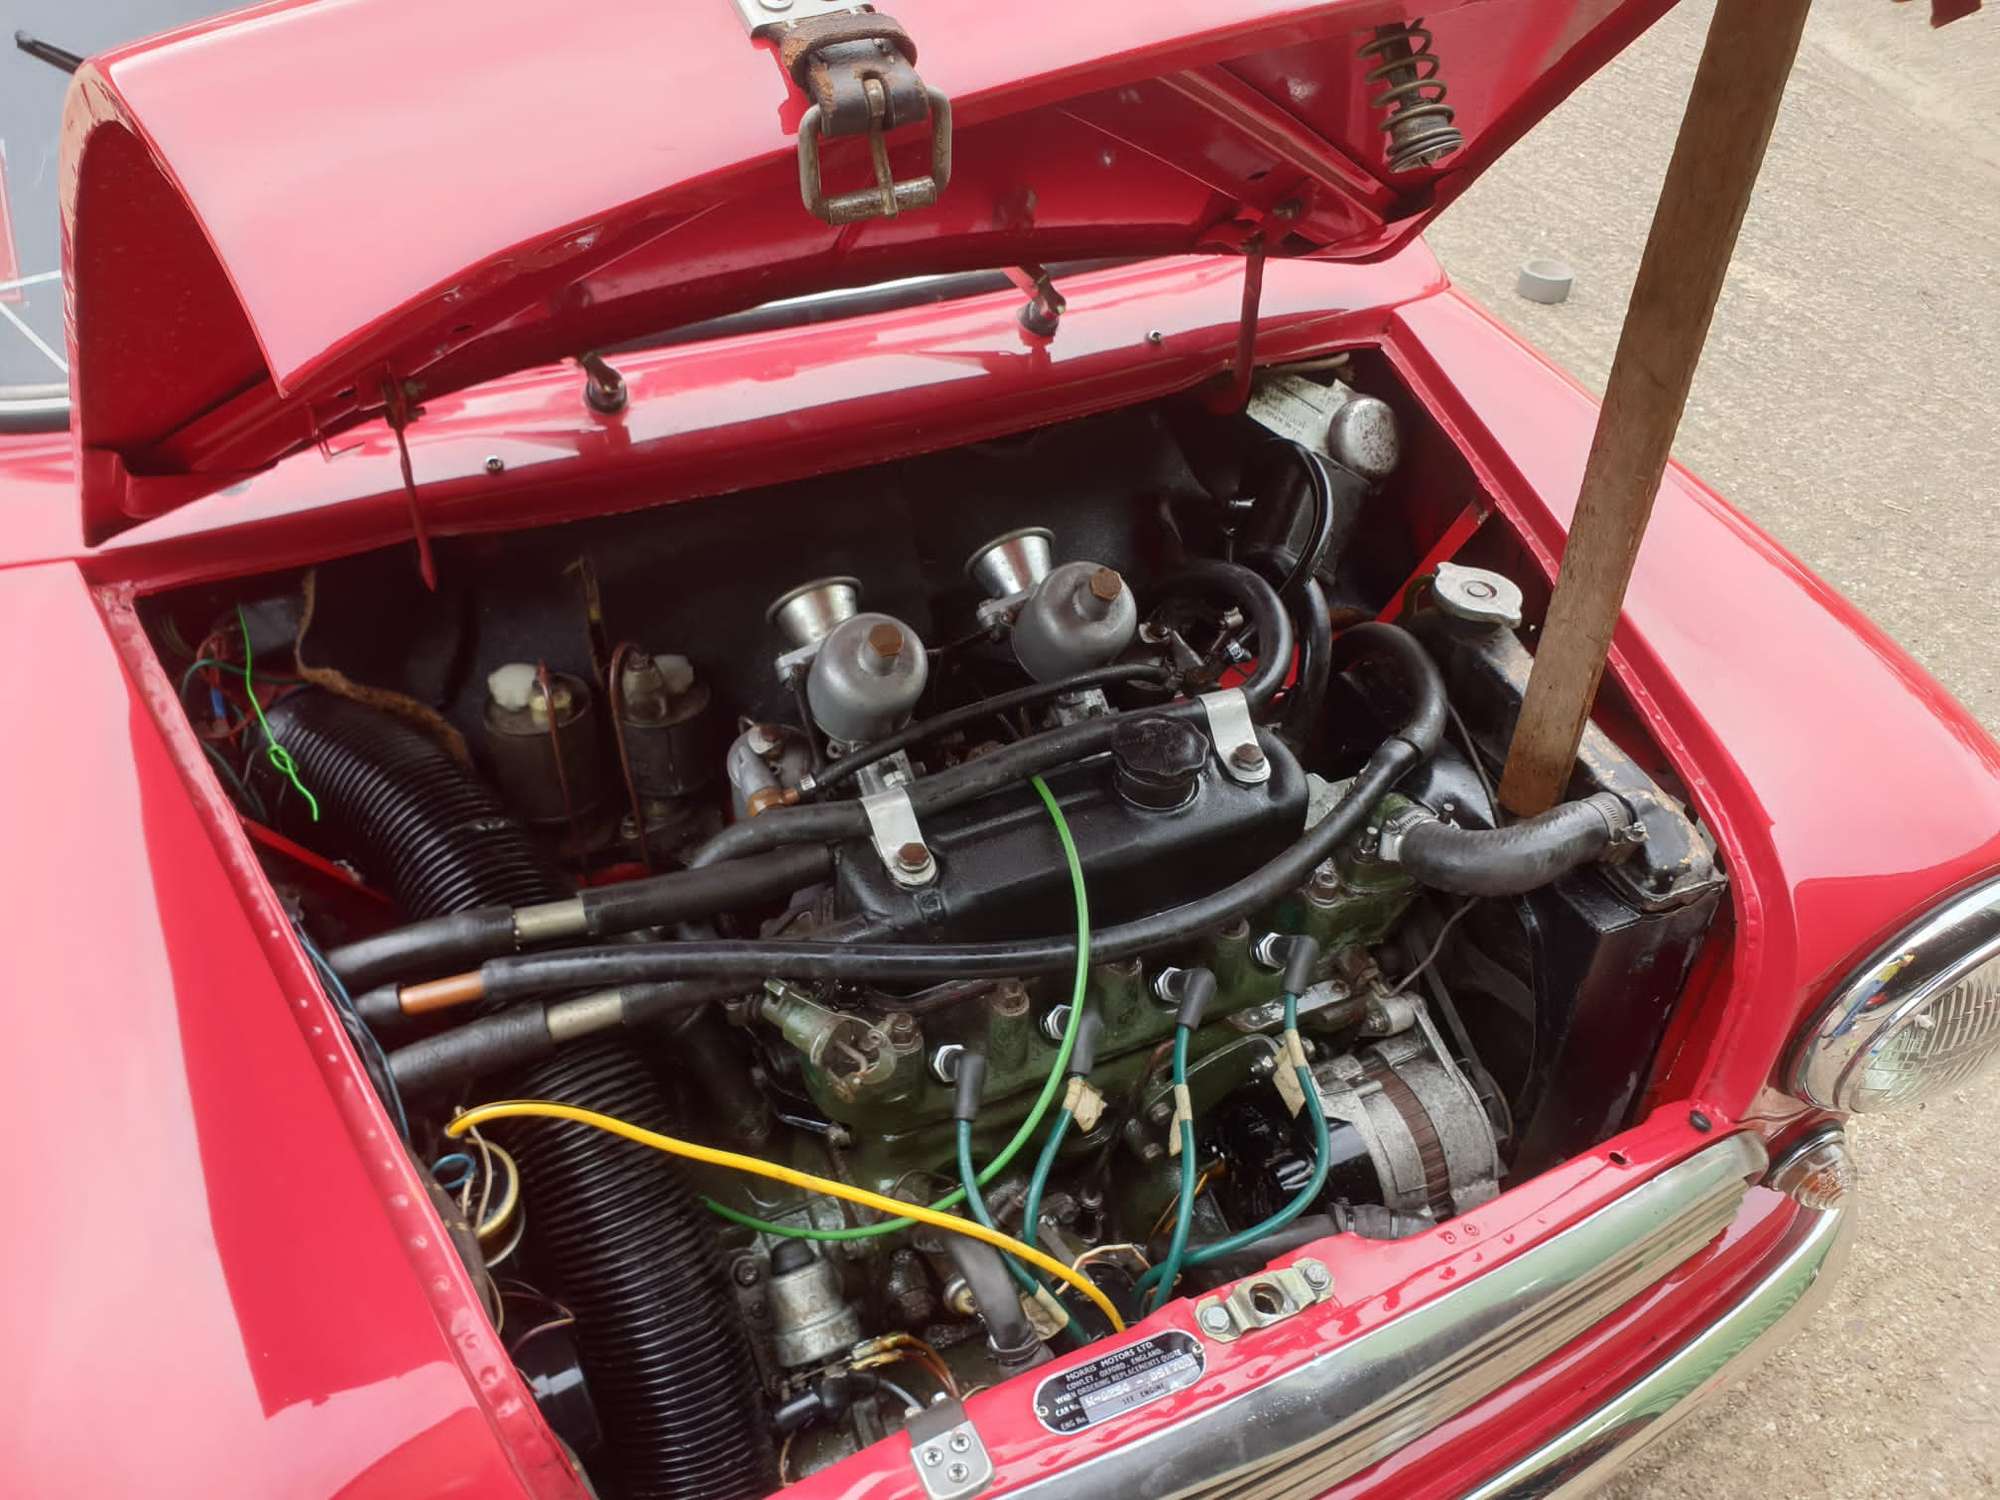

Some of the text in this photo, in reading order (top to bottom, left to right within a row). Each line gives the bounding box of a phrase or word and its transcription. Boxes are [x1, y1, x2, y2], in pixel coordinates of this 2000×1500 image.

[1066, 1362, 1096, 1381] MORRIS
[1100, 1351, 1135, 1367] MOTORS
[1079, 1379, 1110, 1395] ORDERING
[1112, 1359, 1161, 1383] REPLACEMENTS
[1161, 1349, 1182, 1362] QUOTE
